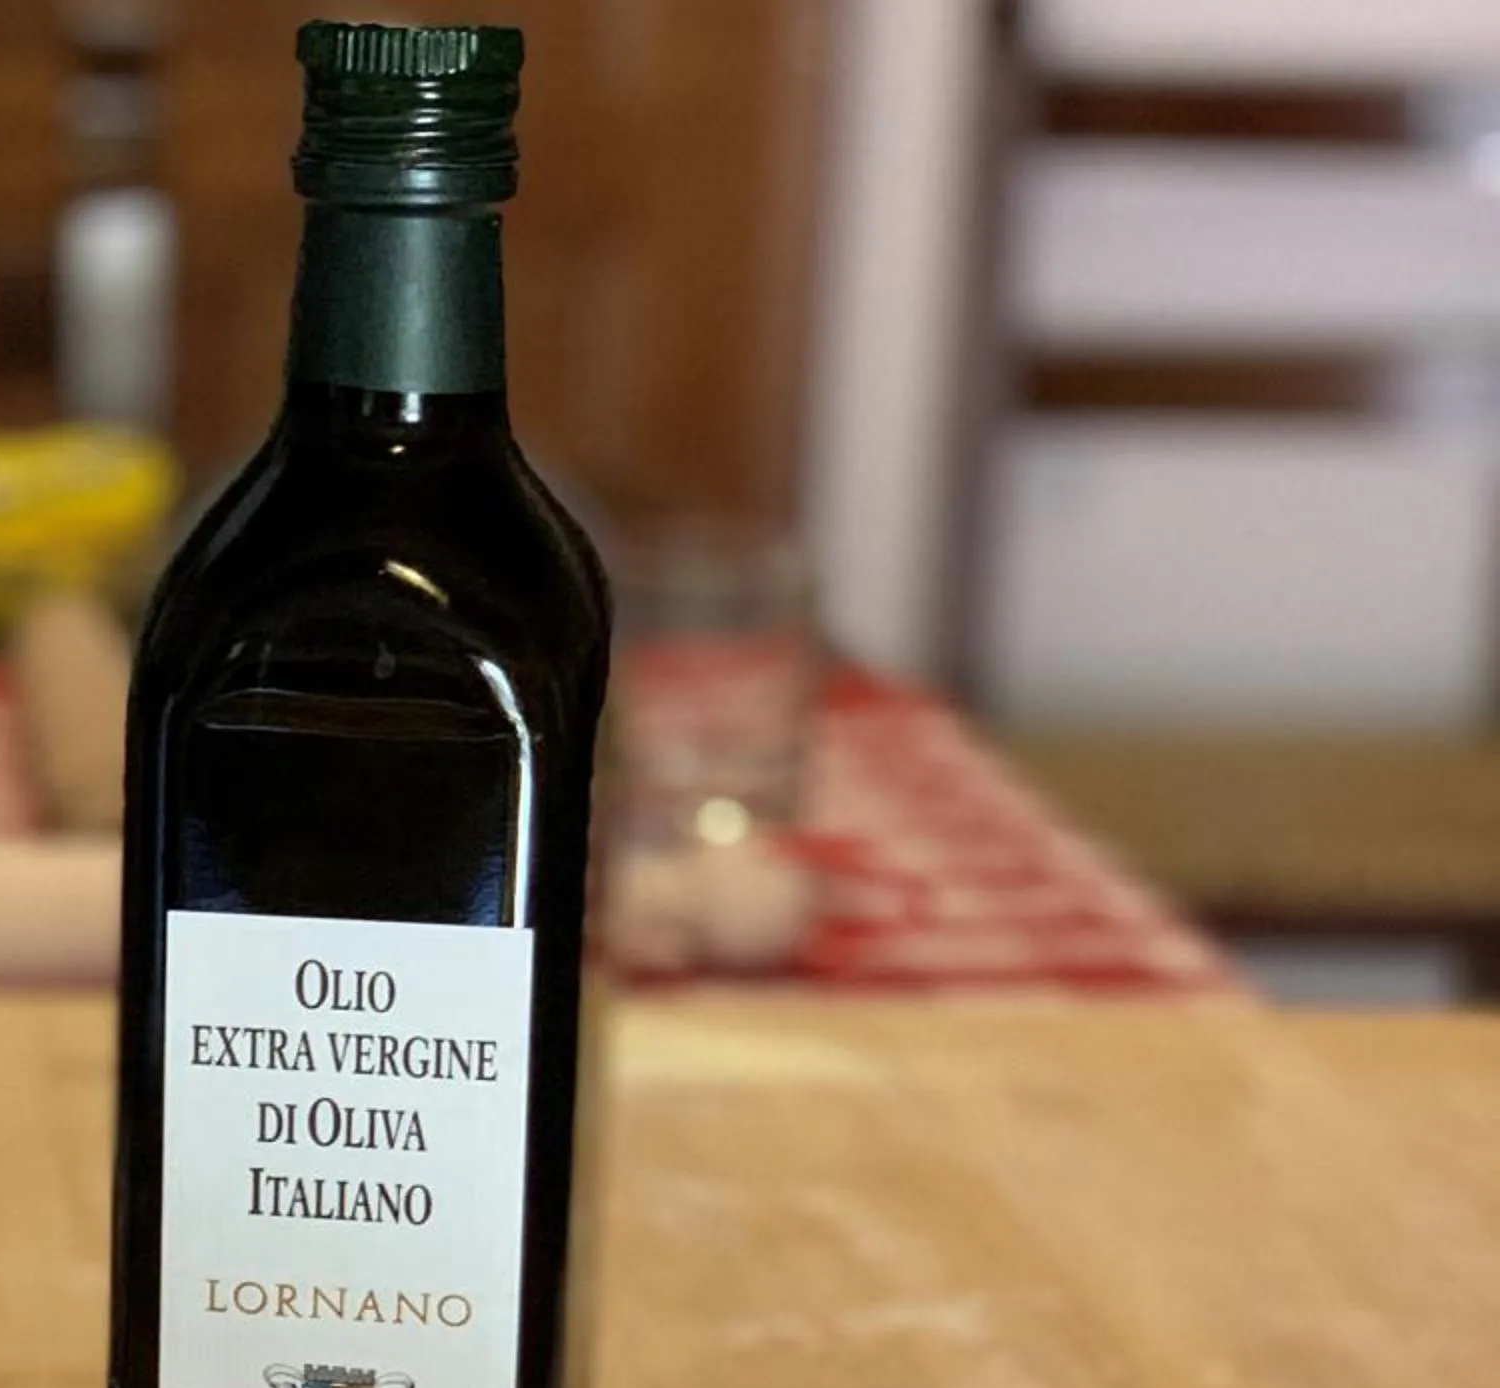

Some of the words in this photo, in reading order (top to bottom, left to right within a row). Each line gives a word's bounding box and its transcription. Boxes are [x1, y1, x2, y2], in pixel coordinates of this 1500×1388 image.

[294, 958, 397, 1013] OLIO
[190, 1024, 316, 1072] EXTRA
[328, 1031, 499, 1082] VERGINE
[256, 1102, 298, 1145] DI
[307, 1096, 428, 1152] OLIVA
[247, 1167, 433, 1225] ITALIANO
[204, 1278, 473, 1328] LORNANO
